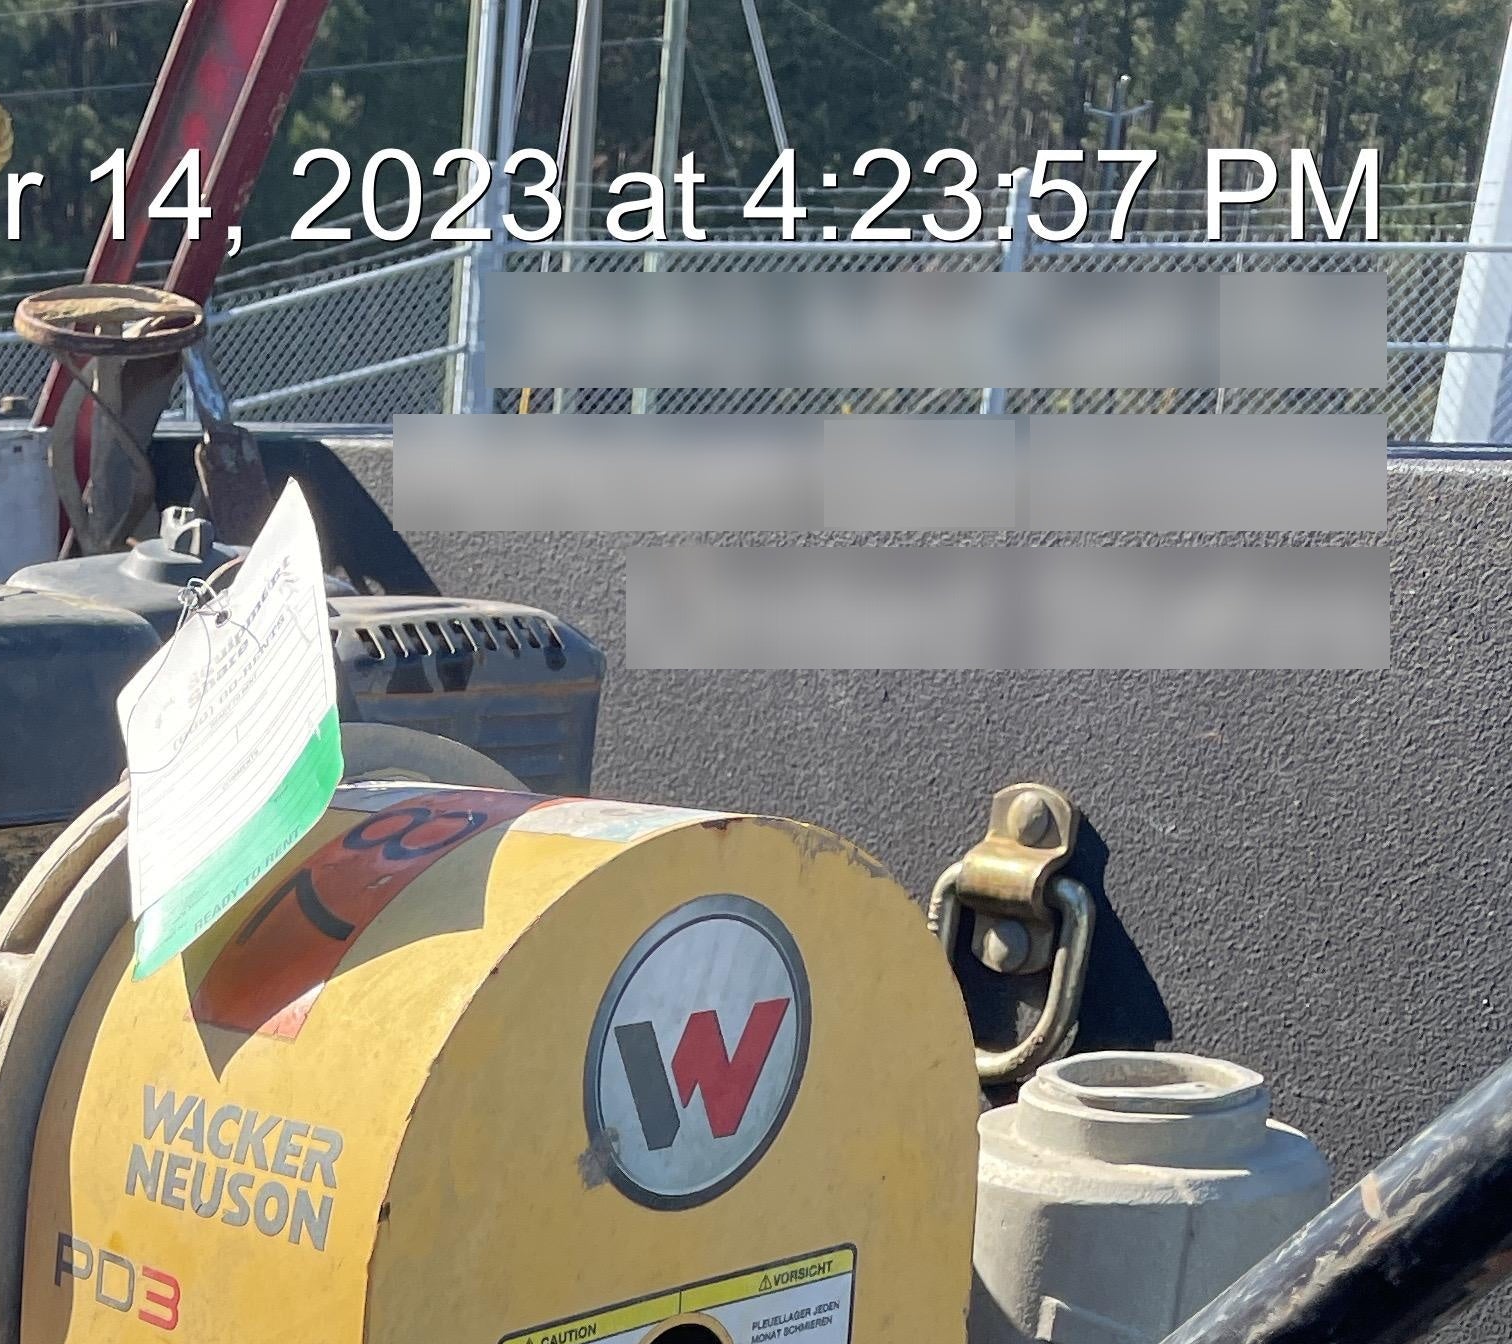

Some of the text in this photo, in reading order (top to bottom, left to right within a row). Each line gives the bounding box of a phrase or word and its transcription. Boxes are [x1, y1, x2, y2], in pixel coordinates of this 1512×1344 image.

[143, 1084, 344, 1189] WACKER
[125, 1144, 334, 1252] NEUSON
[55, 1232, 181, 1332] PD3
[772, 1258, 832, 1288] VORSICHT
